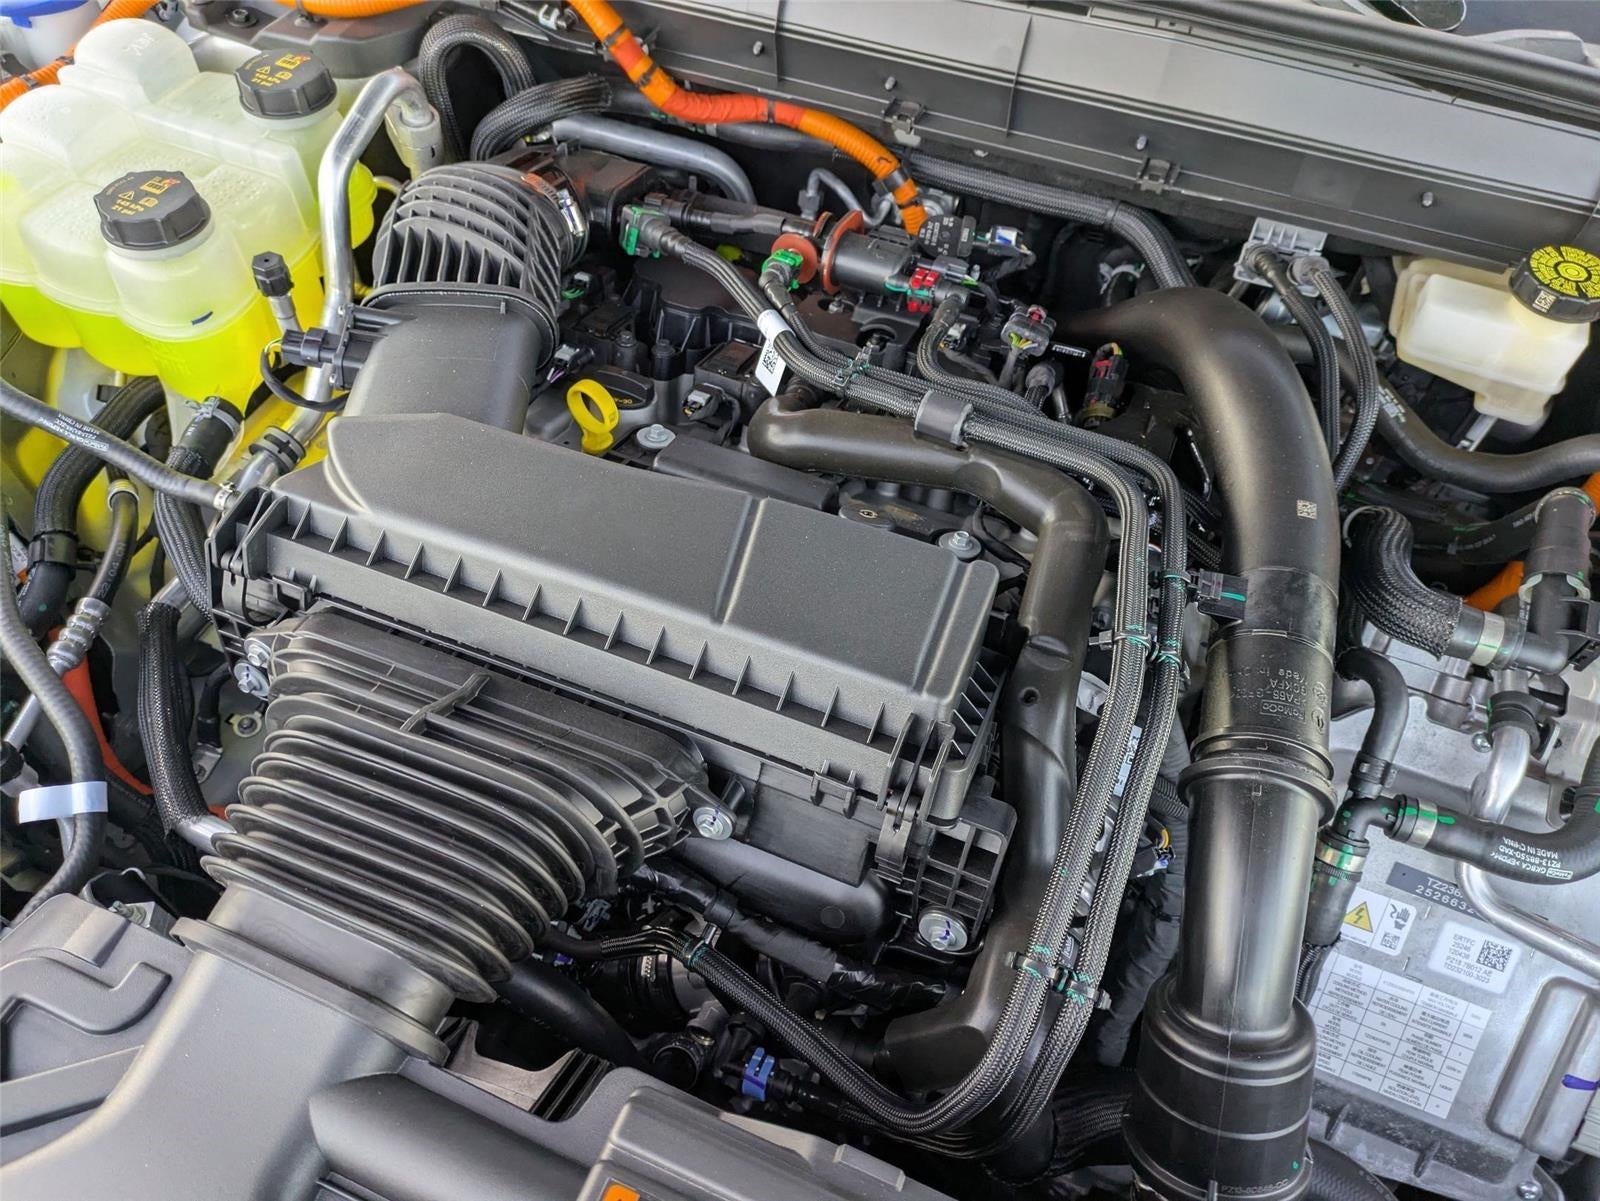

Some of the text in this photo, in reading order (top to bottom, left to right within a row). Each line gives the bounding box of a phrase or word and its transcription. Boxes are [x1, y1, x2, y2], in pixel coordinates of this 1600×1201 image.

[1502, 836, 1559, 860] MADE IN CHINA
[1427, 876, 1464, 898] TZ236
